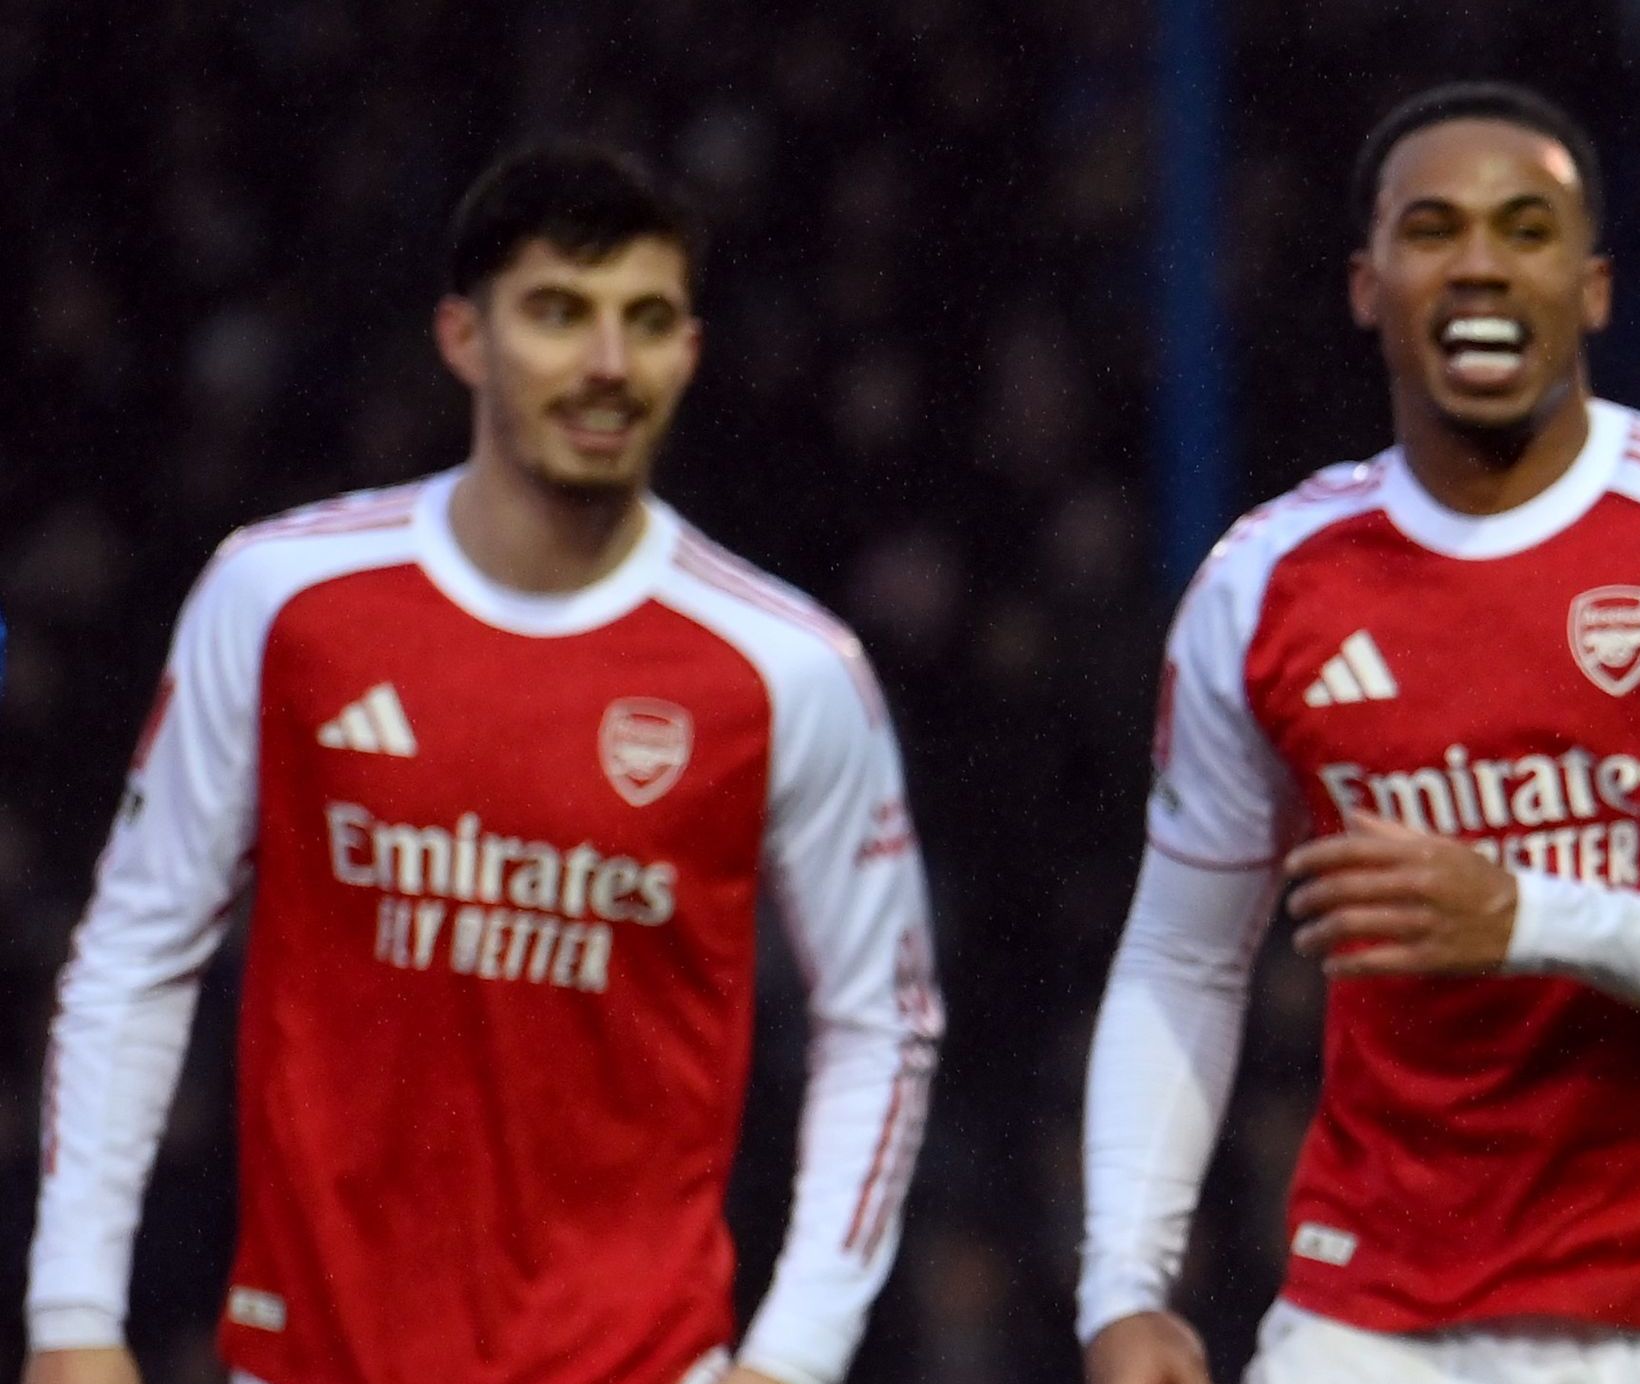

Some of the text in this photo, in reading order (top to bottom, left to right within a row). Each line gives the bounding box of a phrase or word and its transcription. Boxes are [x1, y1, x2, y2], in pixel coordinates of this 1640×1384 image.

[324, 800, 677, 926] Emirates
[374, 893, 614, 994] FLY BETTER
